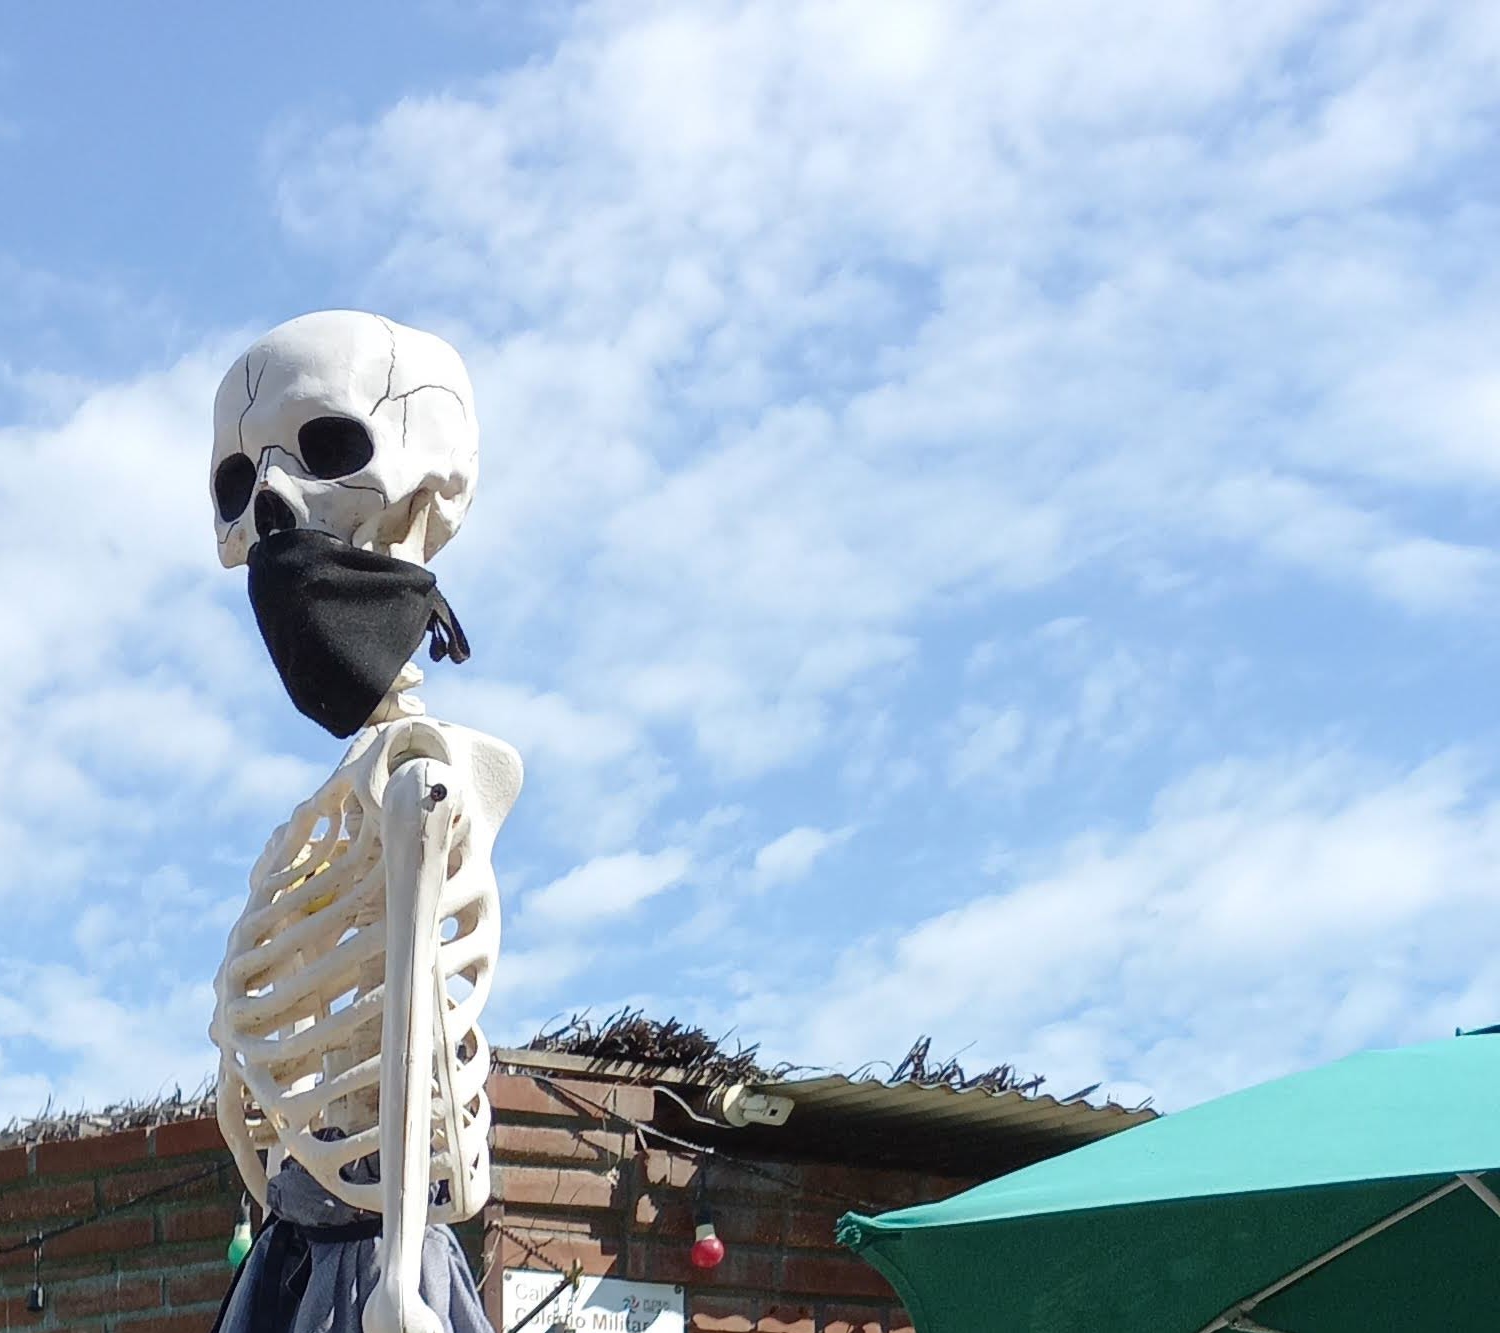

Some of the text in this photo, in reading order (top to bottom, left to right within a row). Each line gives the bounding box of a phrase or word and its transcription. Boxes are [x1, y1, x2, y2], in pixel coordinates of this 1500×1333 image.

[515, 1283, 554, 1301] Call
[515, 1307, 650, 1333] Coleio Militar
